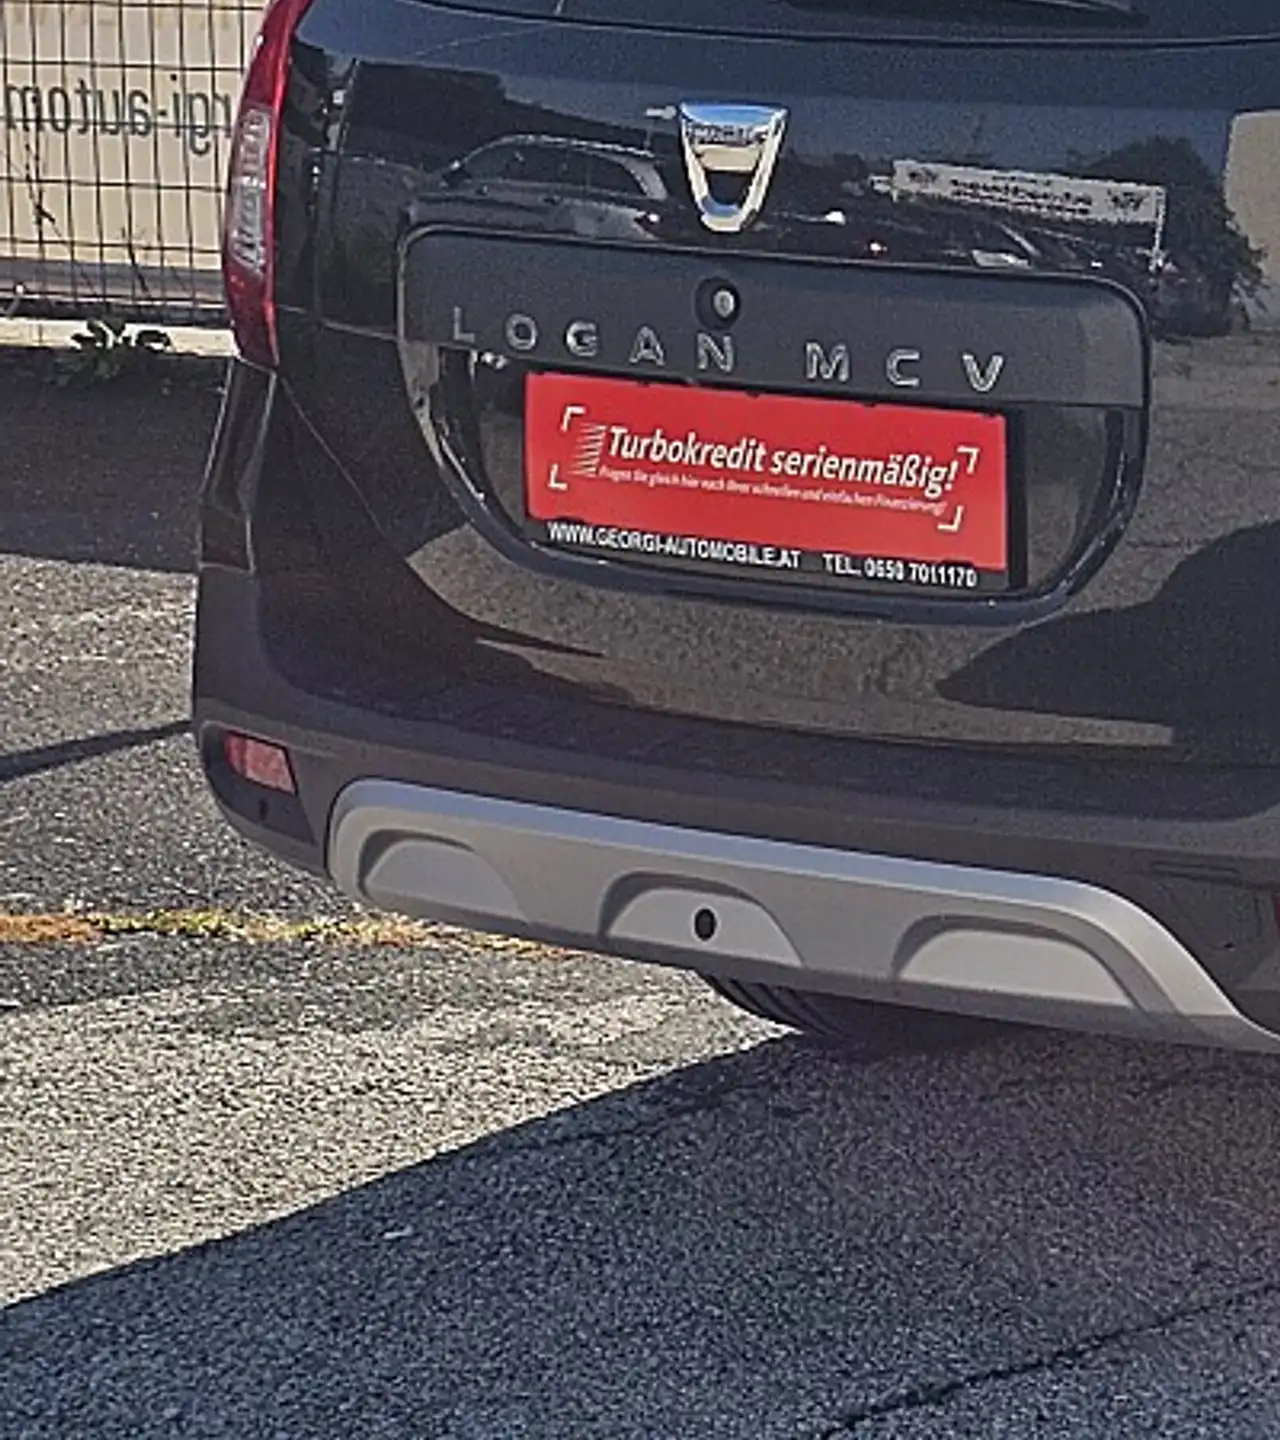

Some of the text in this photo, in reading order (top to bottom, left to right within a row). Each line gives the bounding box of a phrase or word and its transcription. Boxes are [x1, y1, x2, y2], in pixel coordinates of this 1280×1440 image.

[452, 306, 1005, 393] LOGAN MCV
[608, 425, 959, 498] Turbokredit serienmäßig!
